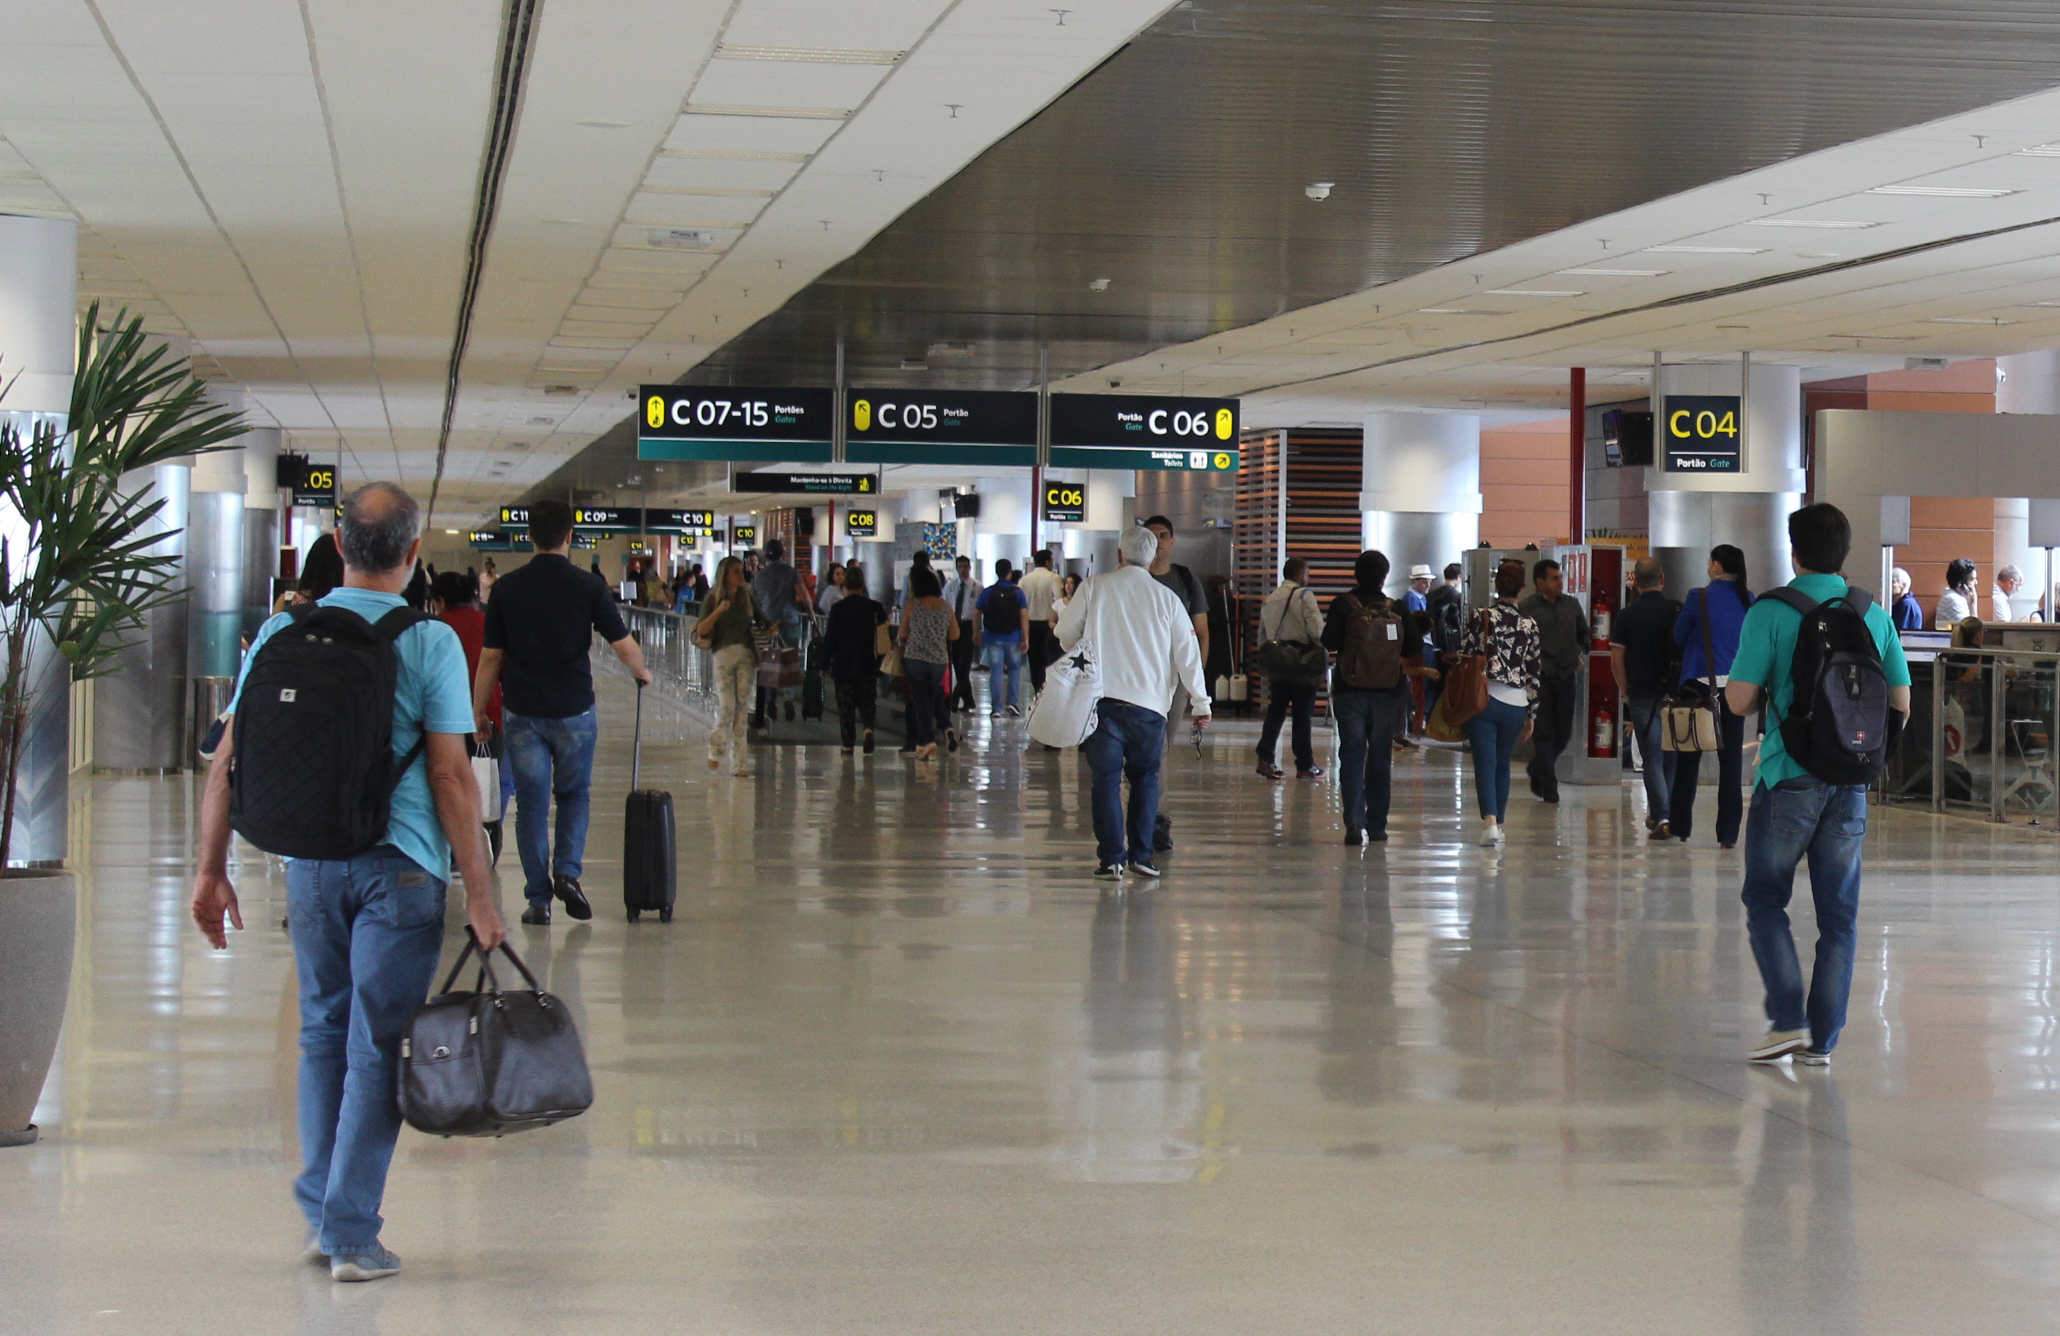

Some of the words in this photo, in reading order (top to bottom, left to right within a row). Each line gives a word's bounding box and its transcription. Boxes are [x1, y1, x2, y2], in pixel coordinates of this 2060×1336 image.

[671, 399, 690, 425] C
[697, 400, 769, 426] 07-15
[775, 405, 804, 414] Portões
[943, 408, 969, 417] Portão
[775, 415, 796, 423] Gates
[878, 403, 897, 428] C
[903, 405, 937, 429] 05
[1118, 412, 1143, 422] Portão
[944, 418, 961, 426] Gate
[1125, 423, 1143, 431] Gate
[1149, 409, 1167, 435] C
[1173, 410, 1209, 436] 06
[1670, 410, 1691, 438] C
[1696, 410, 1738, 438] 04
[1677, 458, 1706, 468] Portão
[1710, 459, 1731, 468] Gate
[310, 471, 333, 488] 05
[1047, 490, 1059, 506] C
[1061, 490, 1082, 506] 06
[511, 510, 519, 521] C
[584, 510, 592, 522] C
[593, 511, 607, 522] 09
[683, 513, 691, 524] C
[692, 513, 703, 524] 10
[849, 513, 858, 525] C
[859, 513, 874, 526] 08
[737, 529, 744, 538] C
[745, 529, 753, 538] 10
[681, 536, 687, 544] C
[687, 536, 694, 544] 12
